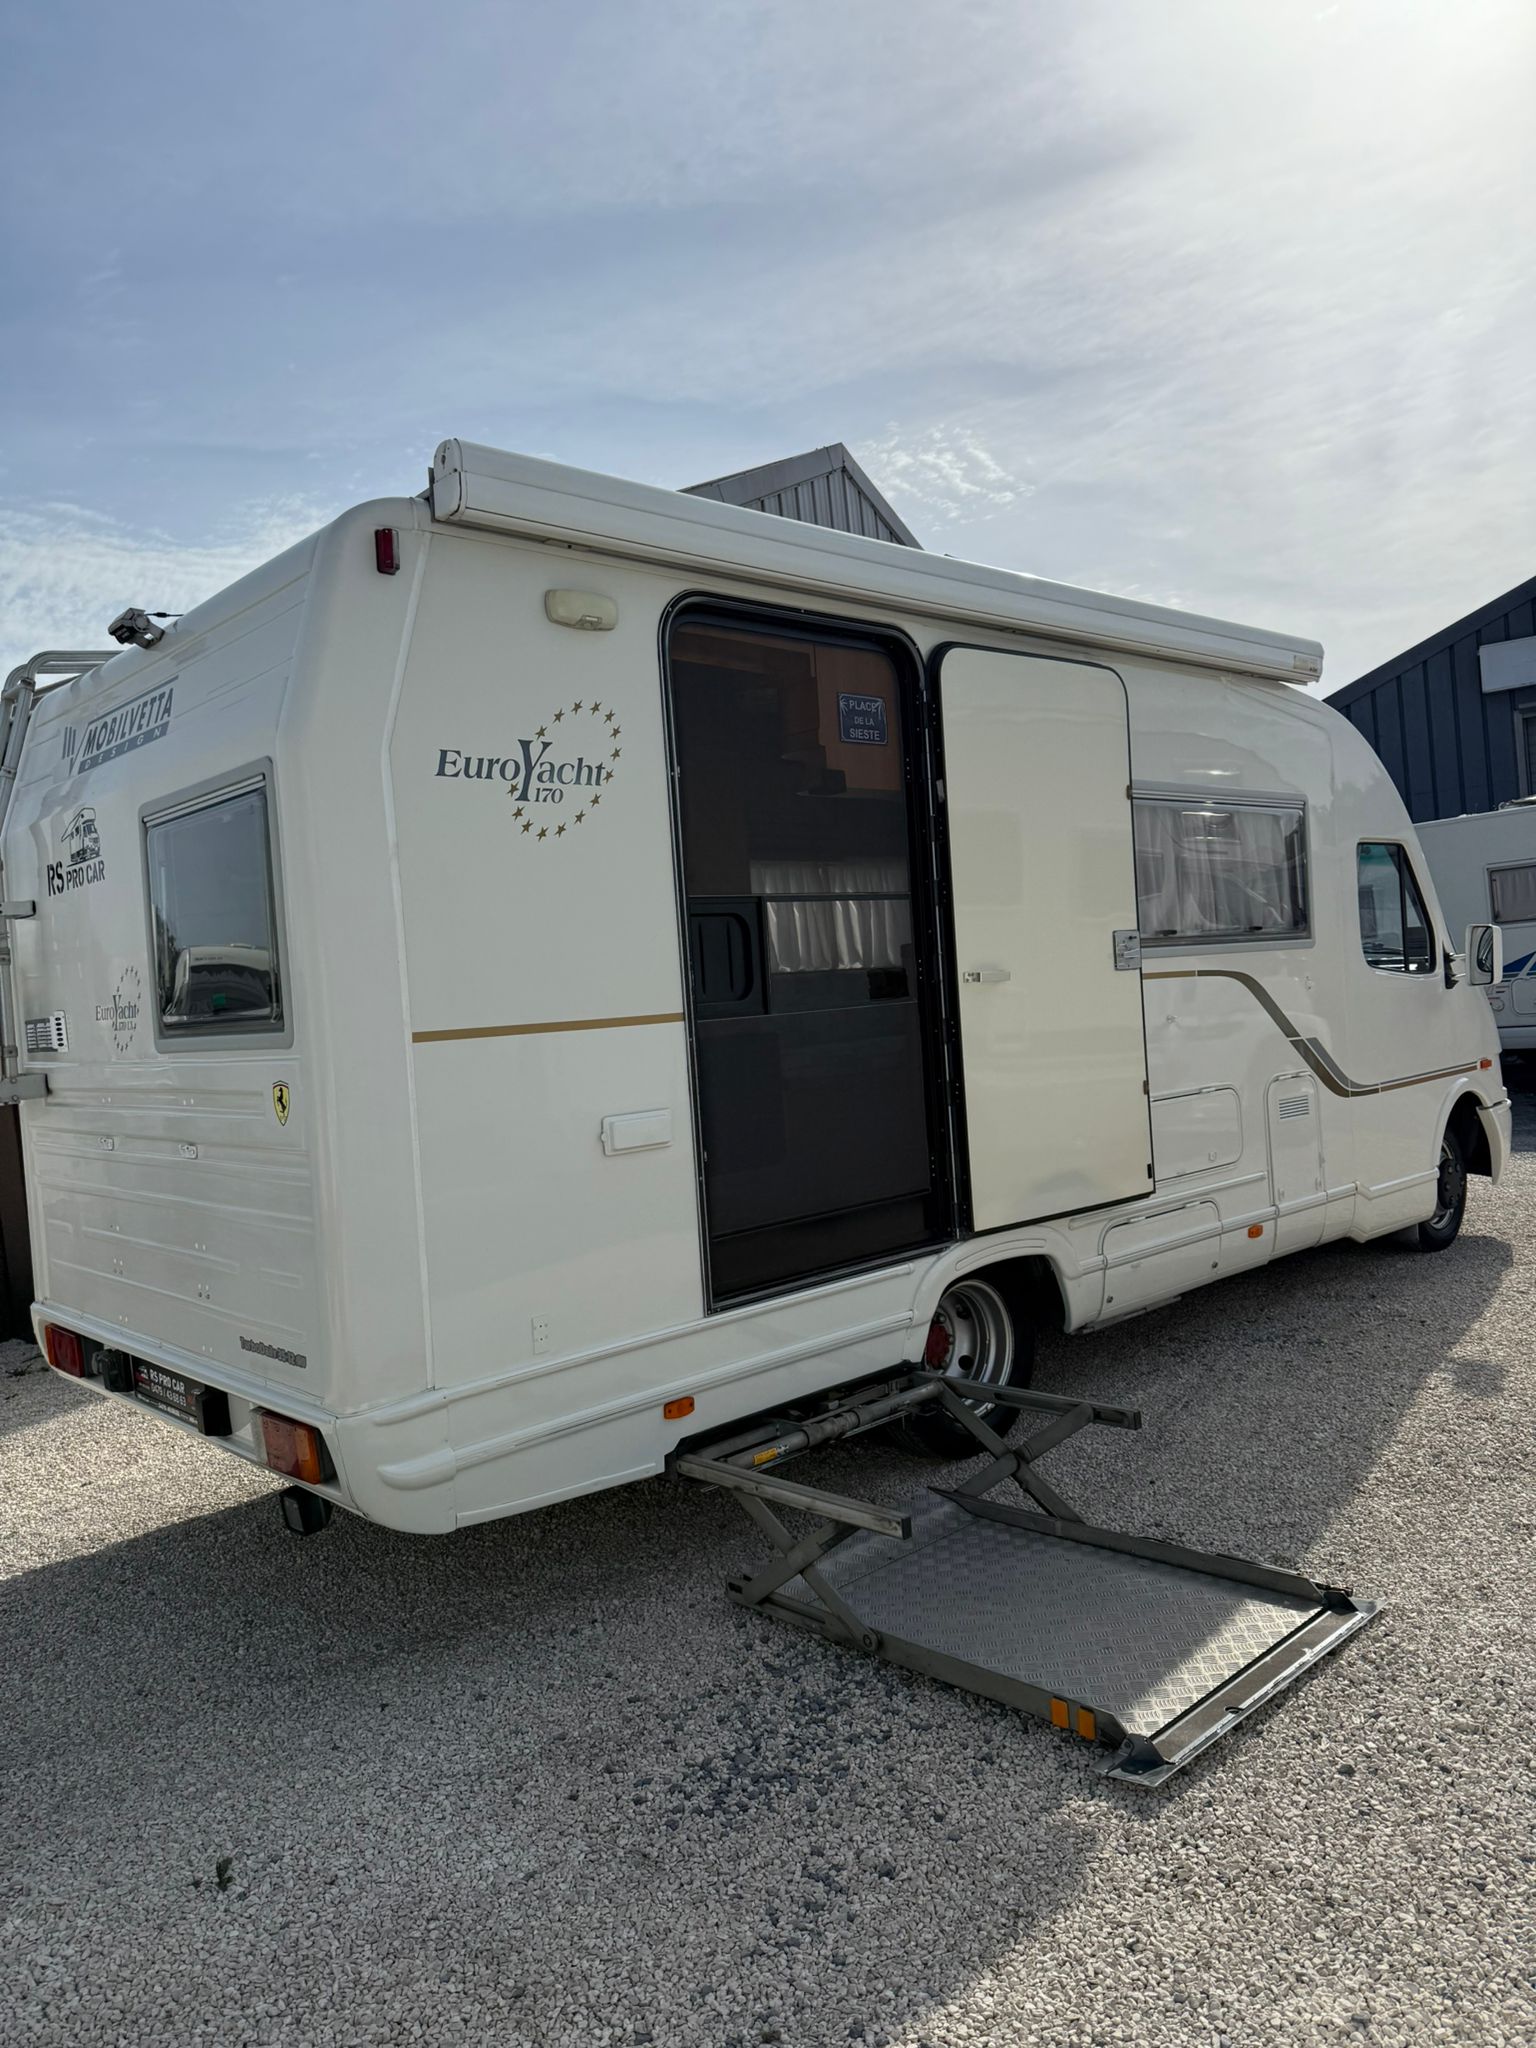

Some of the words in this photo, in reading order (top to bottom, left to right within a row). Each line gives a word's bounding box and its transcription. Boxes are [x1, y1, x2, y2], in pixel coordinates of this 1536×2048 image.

[849, 700, 877, 712] PLACE
[854, 716, 864, 725] DE
[865, 717, 875, 727] LA
[82, 687, 174, 758] MOBILVETTA
[850, 728, 880, 741] SIESTE
[84, 729, 162, 770] DESIGN
[434, 739, 606, 802] EuroYacht
[534, 787, 564, 804] 170
[47, 861, 65, 897] RS
[66, 867, 84, 891] PRO
[86, 860, 105, 885] CAR
[95, 994, 137, 1031] EuroYacht
[149, 1368, 159, 1383] RS
[159, 1373, 172, 1388] PRO
[172, 1379, 186, 1395] CAR
